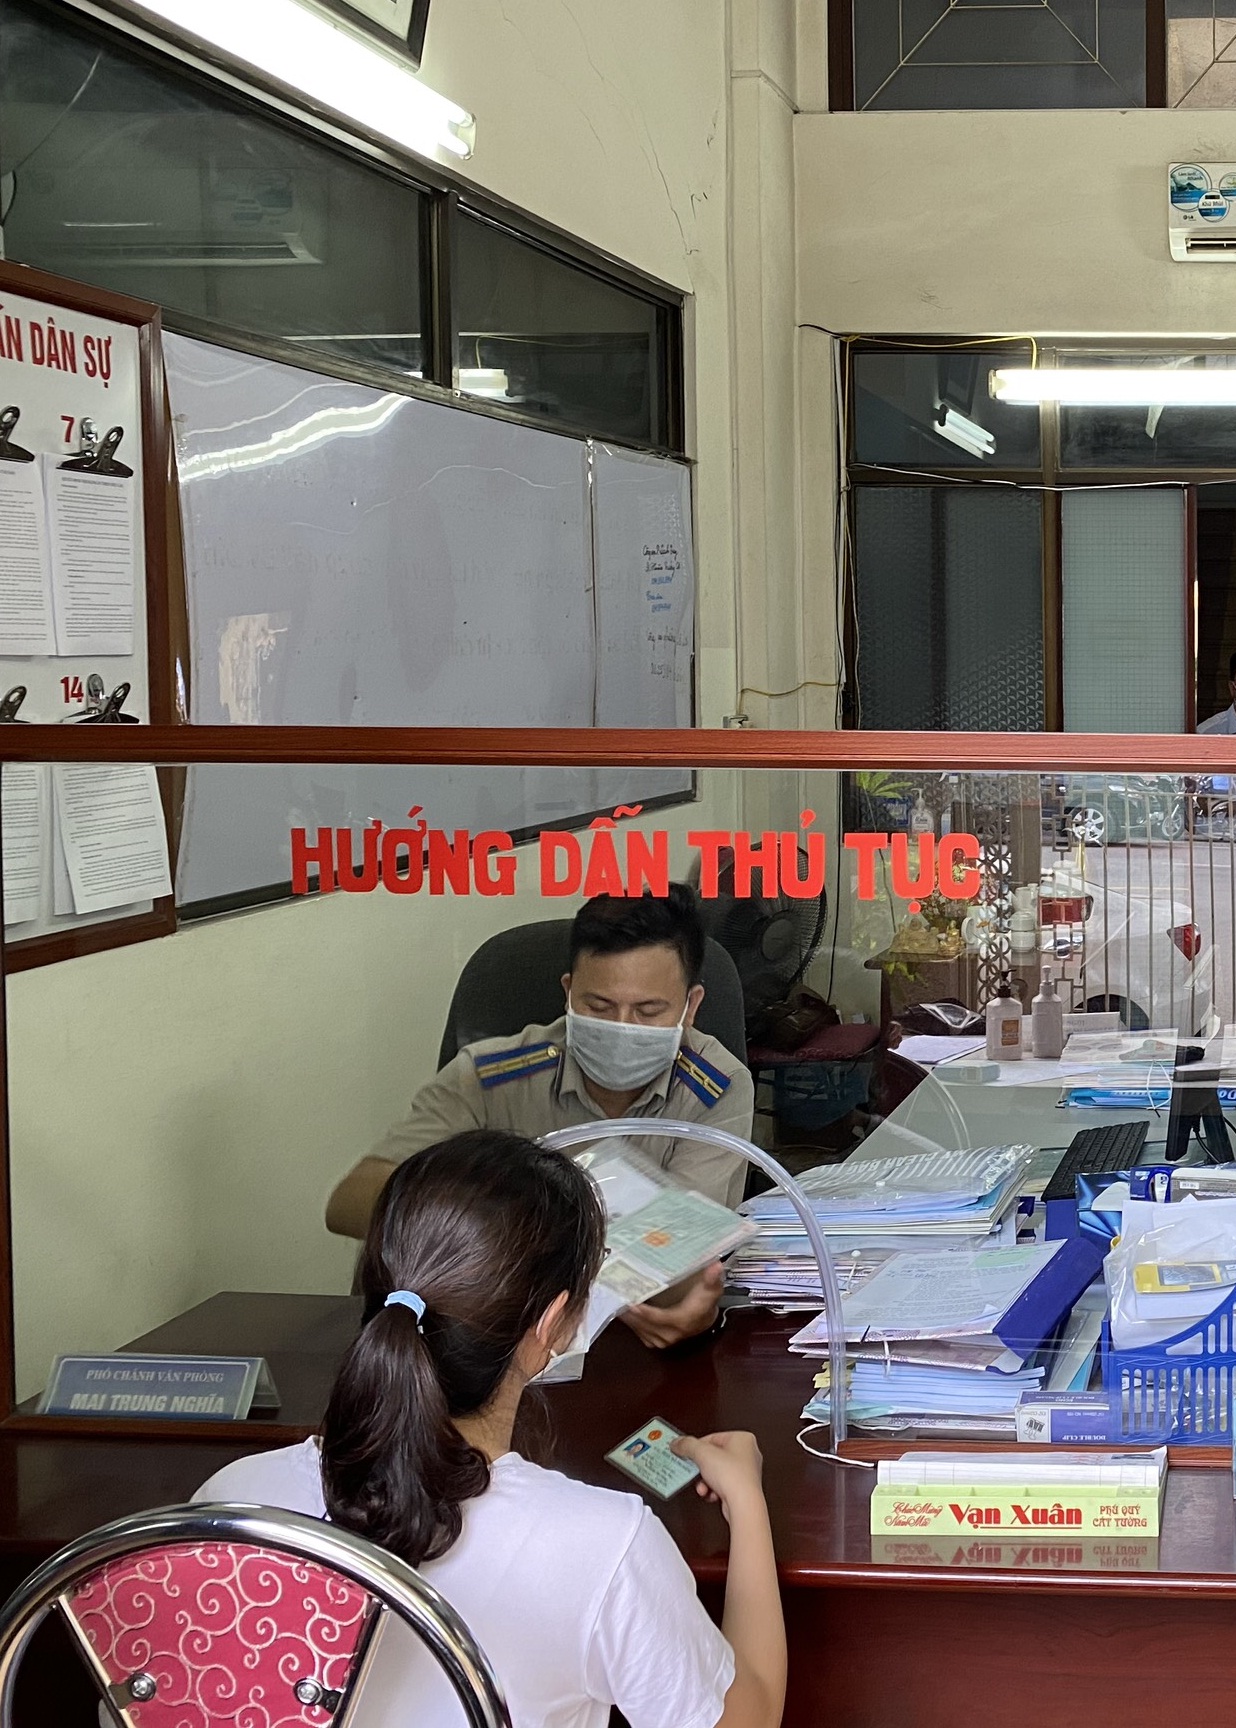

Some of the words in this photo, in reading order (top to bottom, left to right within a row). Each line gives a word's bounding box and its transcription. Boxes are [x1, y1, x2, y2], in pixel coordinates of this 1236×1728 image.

[29, 316, 78, 374] DÂN
[83, 334, 113, 389] SỰ
[60, 415, 76, 443] 7
[60, 676, 84, 704] 14
[290, 805, 518, 897] HƯỚNG
[540, 804, 670, 898] DẪN
[687, 808, 826, 900] THỦ
[844, 832, 980, 915] TỤC
[86, 1367, 112, 1380] PHÓ
[112, 1368, 156, 1381] CHÁNH
[70, 1394, 107, 1410] MAI
[110, 1394, 168, 1412] TRUNG
[170, 1393, 225, 1414] NGHĨA
[949, 1504, 1001, 1529] Vạn
[1010, 1503, 1082, 1525] Xuân
[1092, 1516, 1112, 1527] CÁT
[1114, 1516, 1147, 1527] TƯỜNG
[1100, 1504, 1119, 1516] PHÚ
[1121, 1504, 1141, 1516] QUÝ
